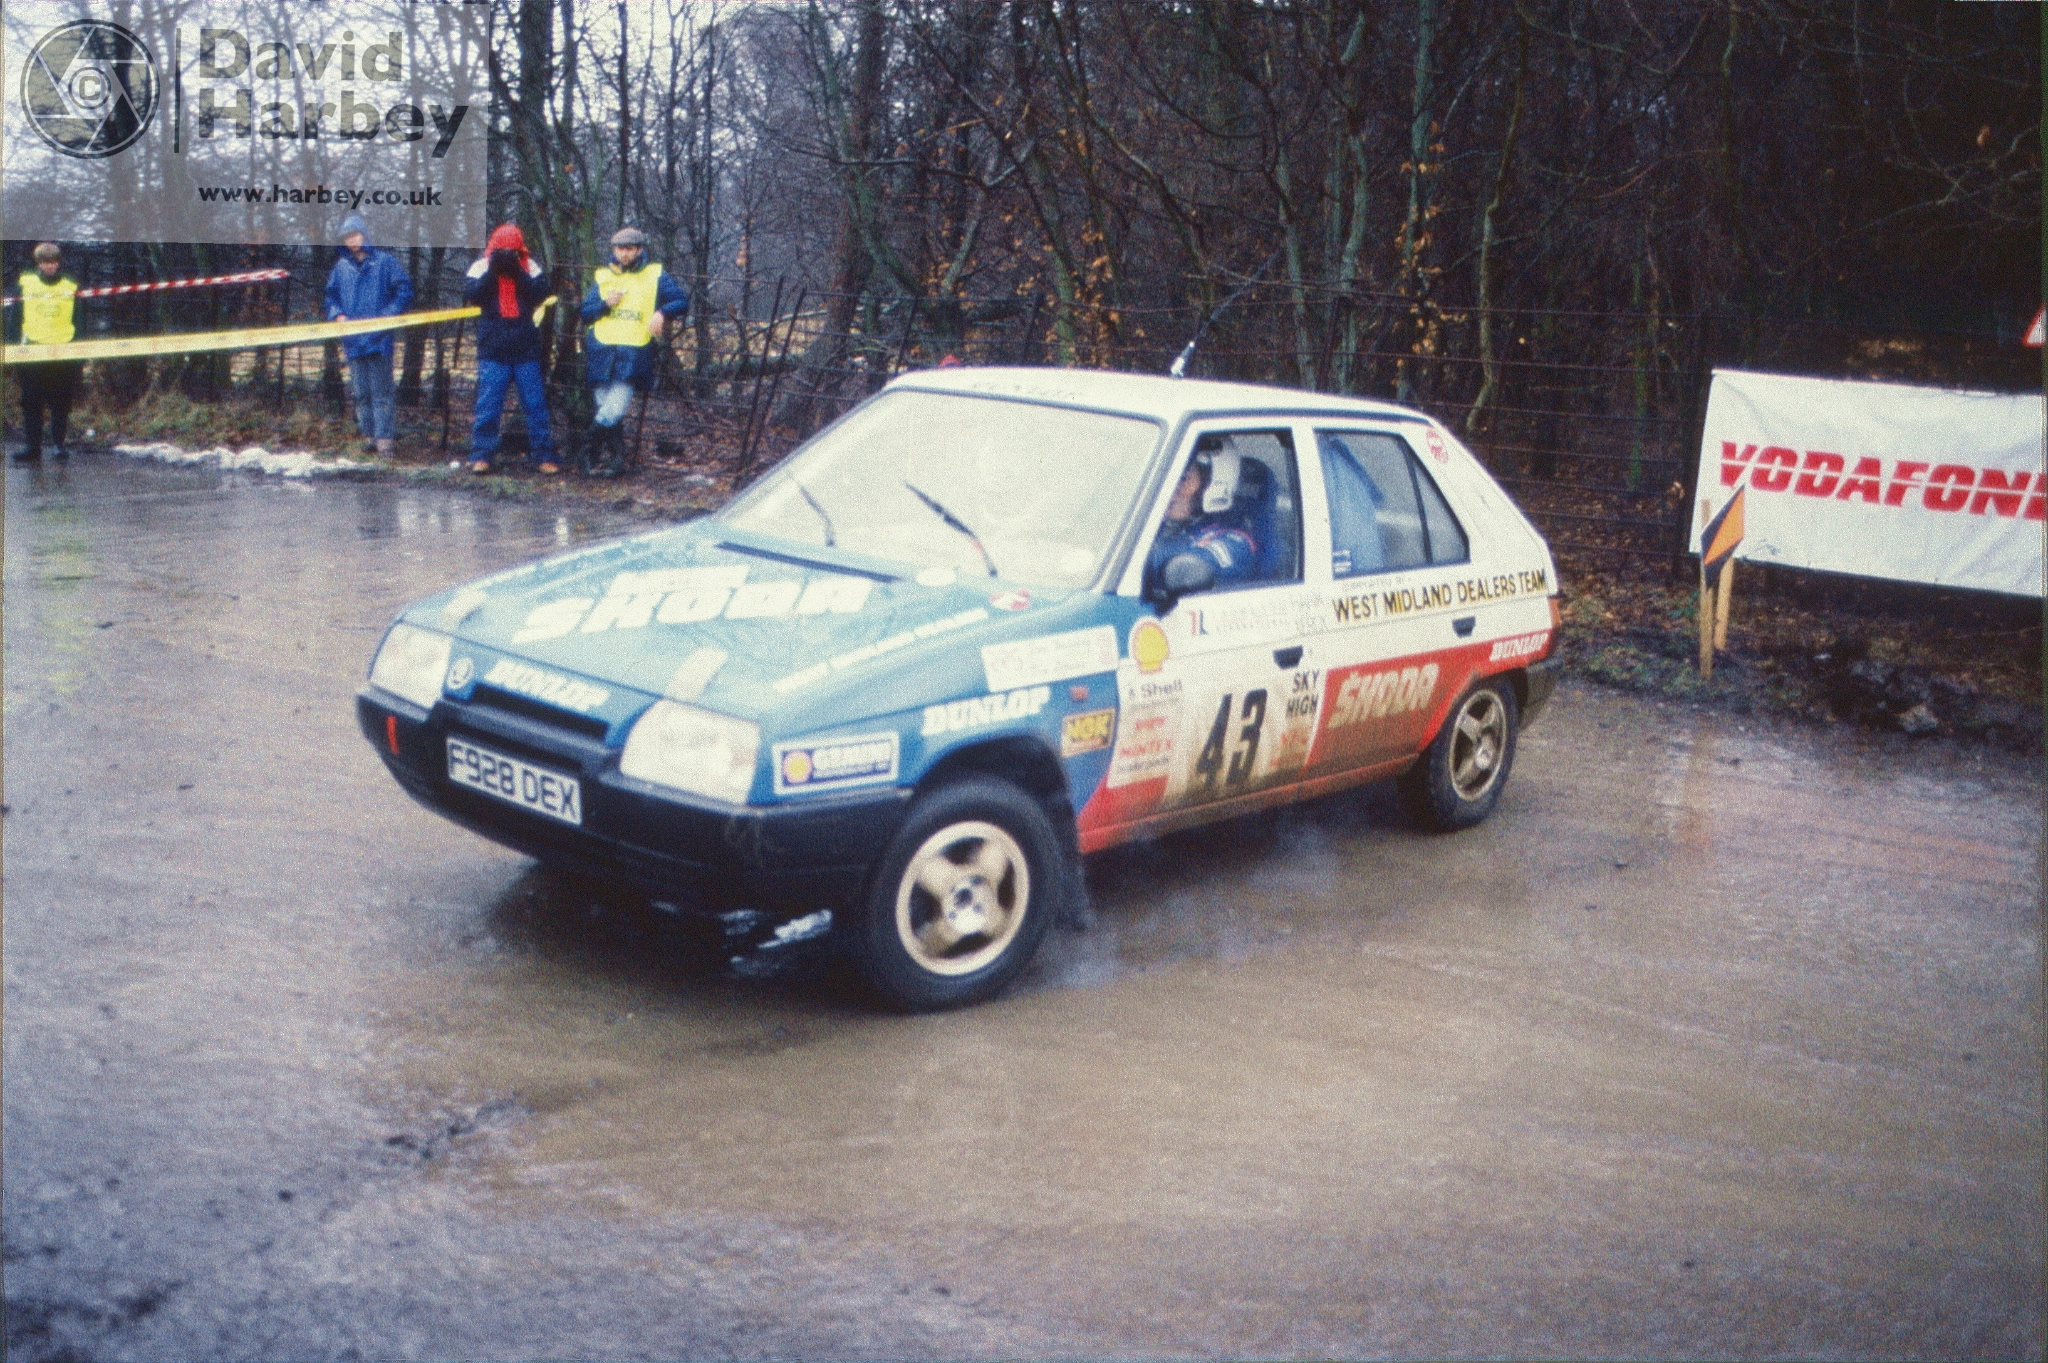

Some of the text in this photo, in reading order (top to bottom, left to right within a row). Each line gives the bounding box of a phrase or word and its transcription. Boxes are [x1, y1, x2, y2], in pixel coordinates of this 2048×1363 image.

[1333, 592, 1378, 623] WEST
[1382, 583, 1452, 616] MIDLAND
[1457, 573, 1517, 604] DEALERS
[1518, 568, 1547, 593] TEAM
[1489, 632, 1549, 662] DUNLOP
[1292, 670, 1320, 694] SKY
[921, 686, 1050, 736] DUNLOP
[1195, 688, 1268, 788] 43
[450, 743, 578, 821] F928 DEX
